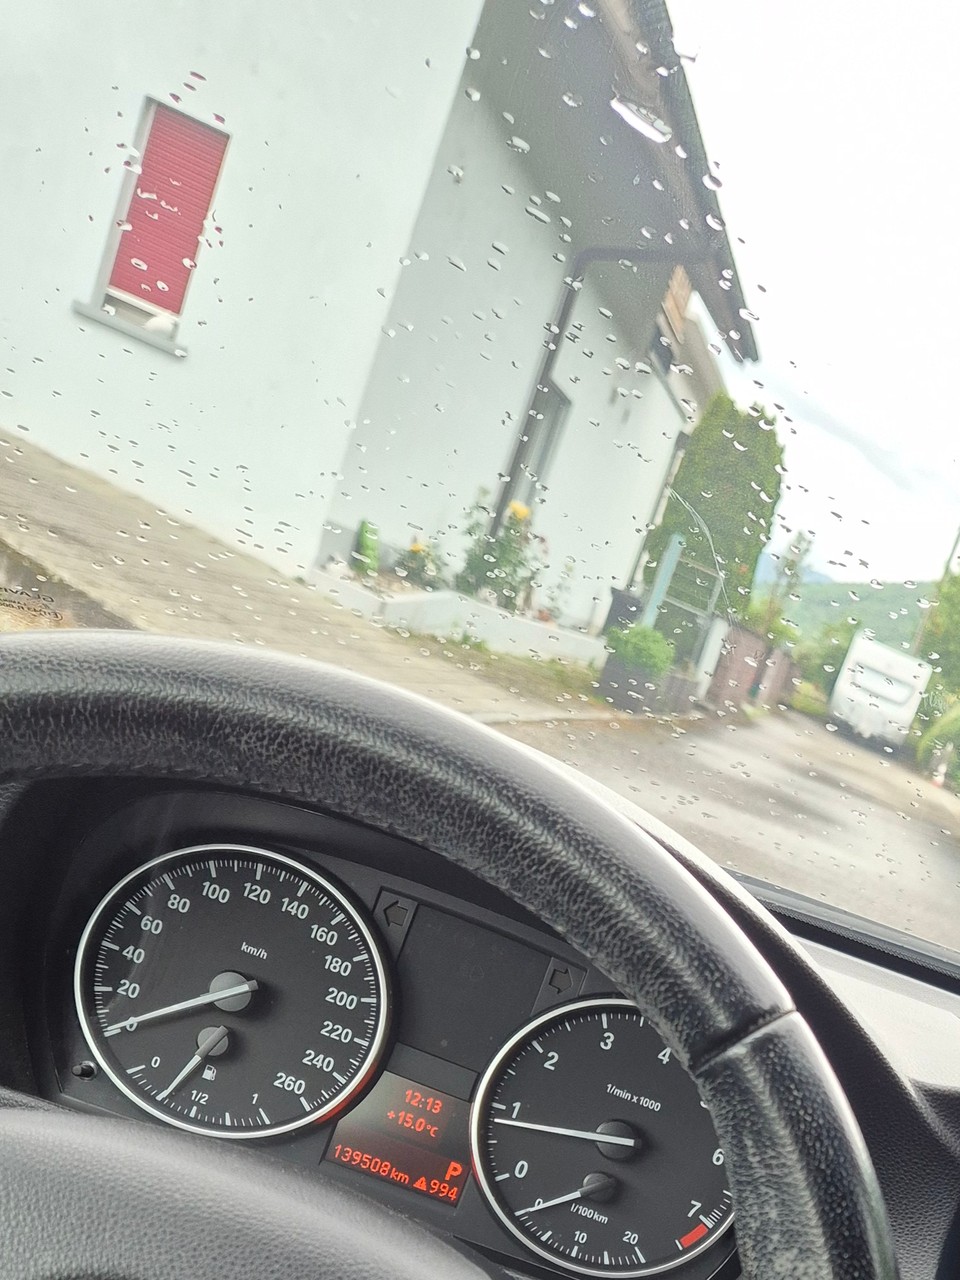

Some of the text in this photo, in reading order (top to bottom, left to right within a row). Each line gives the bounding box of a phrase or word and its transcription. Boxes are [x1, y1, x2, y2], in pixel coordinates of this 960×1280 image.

[201, 881, 231, 904] 100
[243, 882, 272, 905] 120
[167, 893, 191, 914] 80
[280, 897, 310, 920] 140
[140, 915, 163, 935] 60
[309, 924, 338, 946] 160
[121, 944, 146, 964] 40
[240, 941, 268, 960] km/h
[323, 954, 352, 977] 180
[116, 979, 141, 999] 20
[325, 987, 358, 1010] 200
[319, 1021, 353, 1043] 220
[600, 1031, 615, 1050] 3
[150, 1055, 161, 1069] 0
[301, 1049, 335, 1073] 240
[543, 1051, 560, 1071] 2
[657, 1046, 673, 1065] 4
[273, 1072, 306, 1096] 260
[190, 1089, 209, 1106] 1/2
[251, 1092, 259, 1105] 1
[404, 1089, 443, 1114] 12:13
[511, 1101, 522, 1119] 1
[711, 1148, 725, 1166] 6
[444, 1161, 463, 1182] P
[514, 1160, 529, 1179] 0
[429, 1179, 459, 1201] 994
[686, 1200, 702, 1218] 7
[573, 1230, 588, 1245] 10
[622, 1230, 640, 1246] 20
